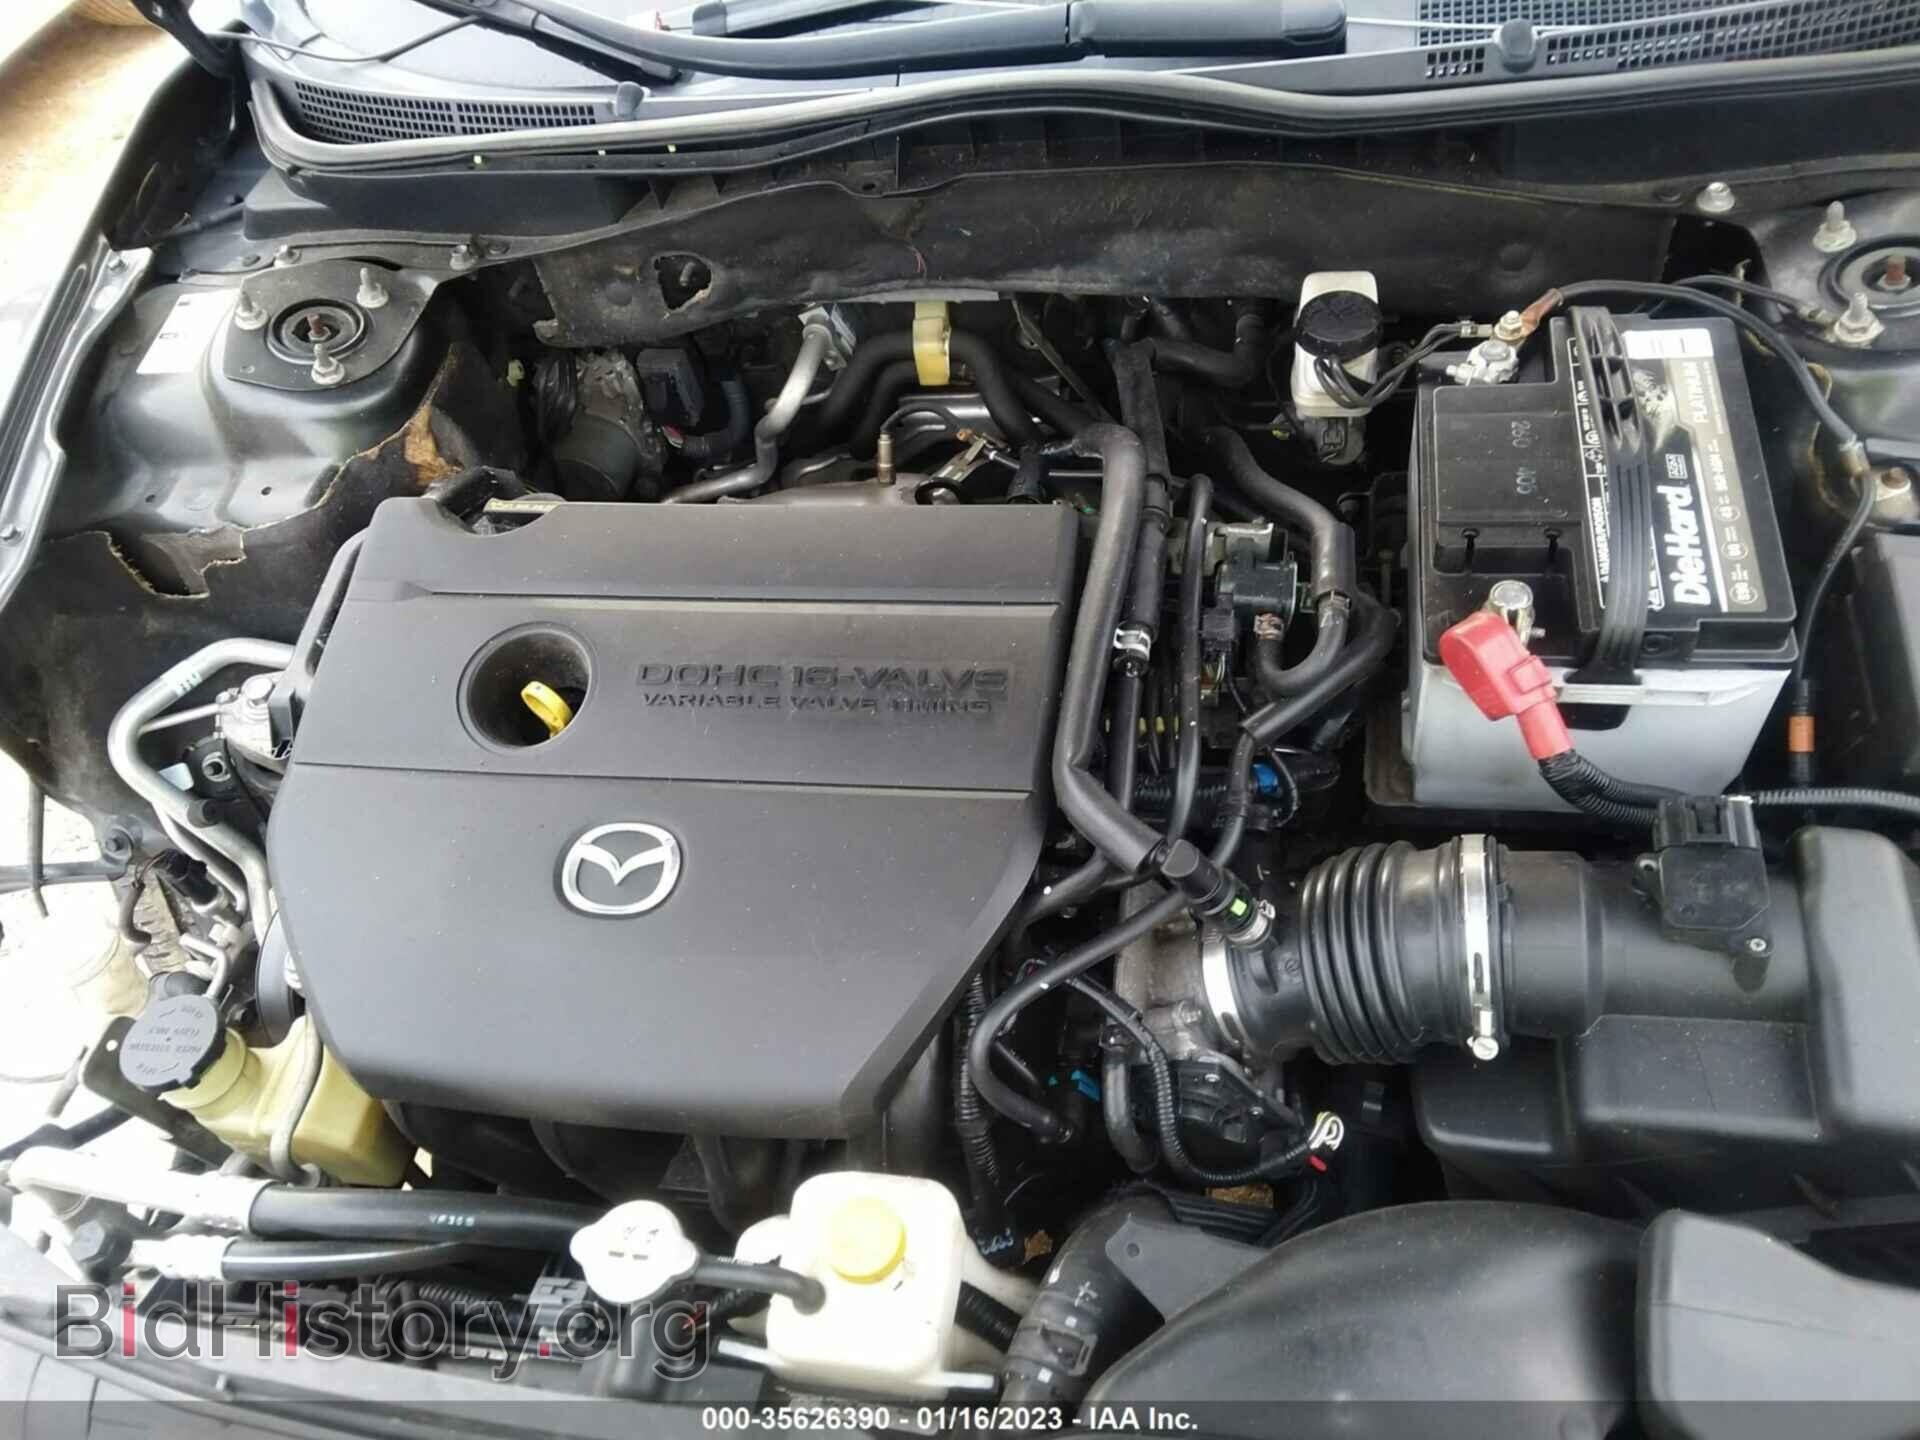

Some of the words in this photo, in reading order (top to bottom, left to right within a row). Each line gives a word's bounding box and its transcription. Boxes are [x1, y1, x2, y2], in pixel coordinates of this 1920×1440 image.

[1656, 485, 1711, 605] DieHard
[636, 663, 780, 688] DOHC
[642, 693, 781, 709] VARIABLE
